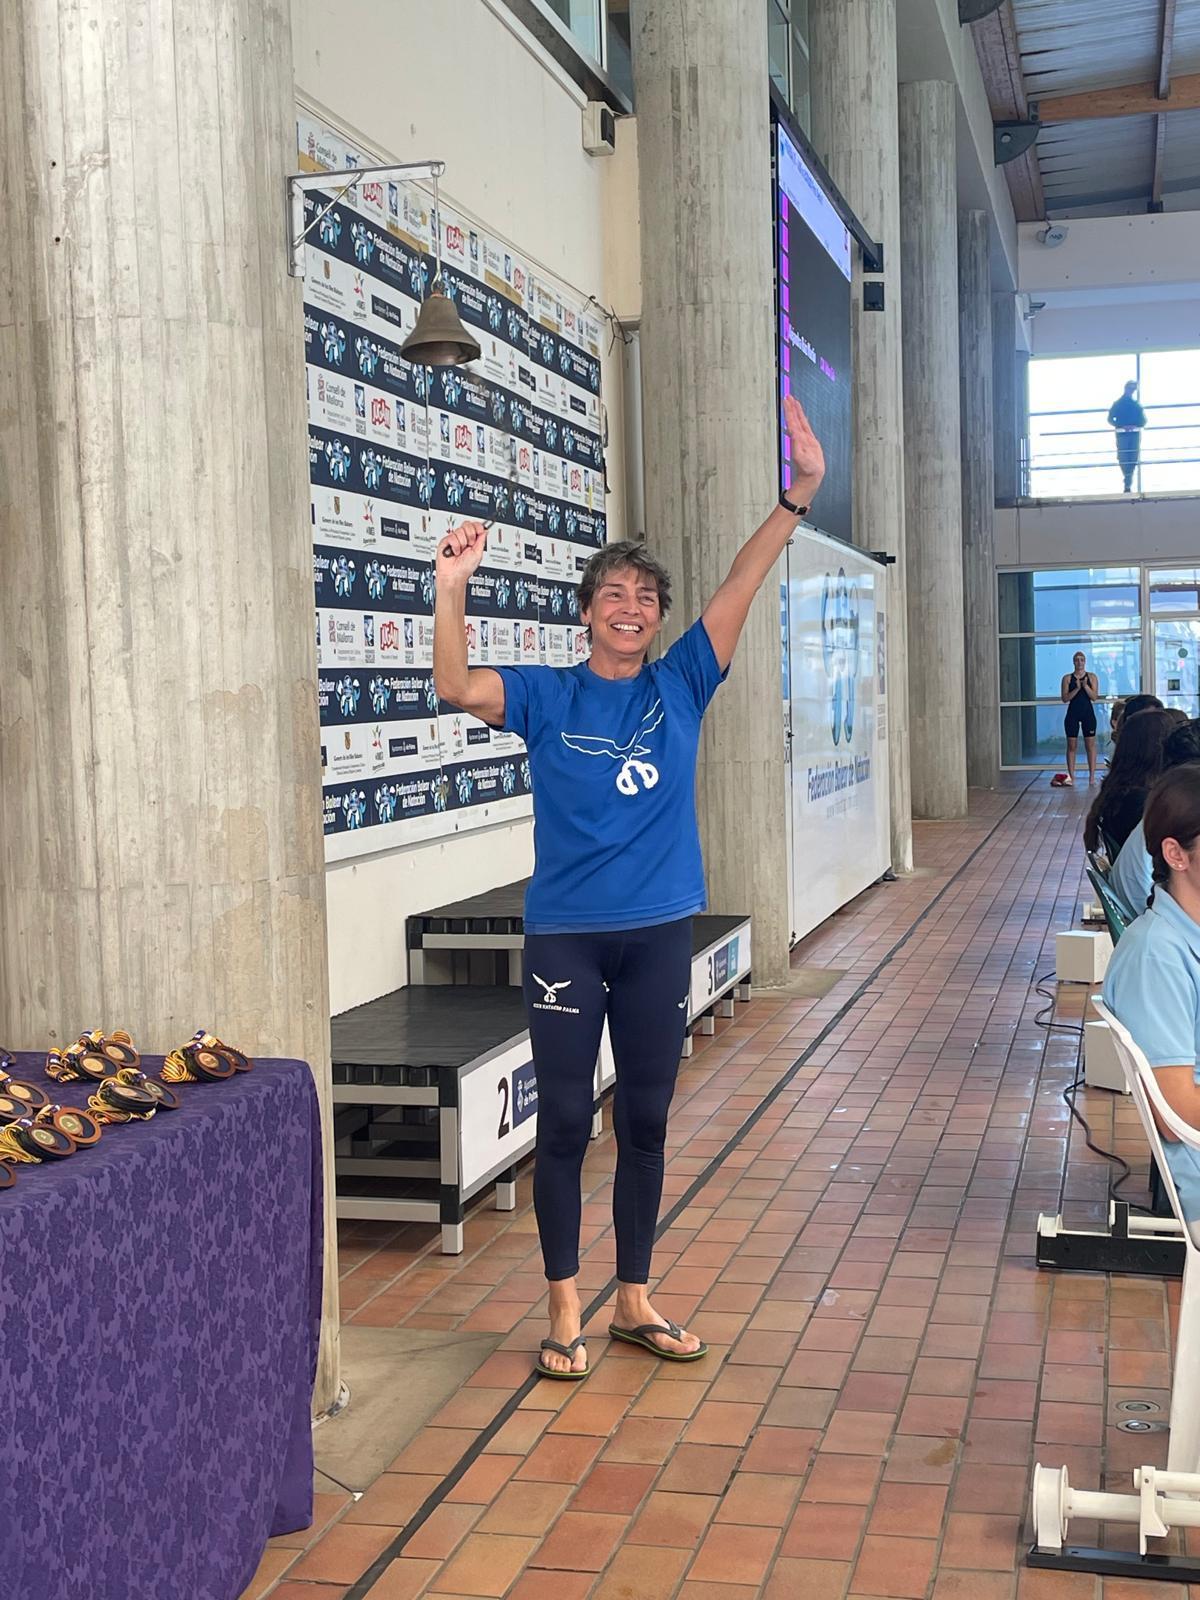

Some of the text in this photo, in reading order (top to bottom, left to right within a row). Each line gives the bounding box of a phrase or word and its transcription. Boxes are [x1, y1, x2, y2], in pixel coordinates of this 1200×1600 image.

[390, 677, 424, 690] Federación Balear
[395, 690, 419, 703] de Natación
[395, 779, 430, 797] Federación Balear
[402, 793, 426, 809] de Natación
[708, 955, 713, 996] 3
[562, 1006, 580, 1014] PALMA
[497, 1076, 510, 1140] 2
